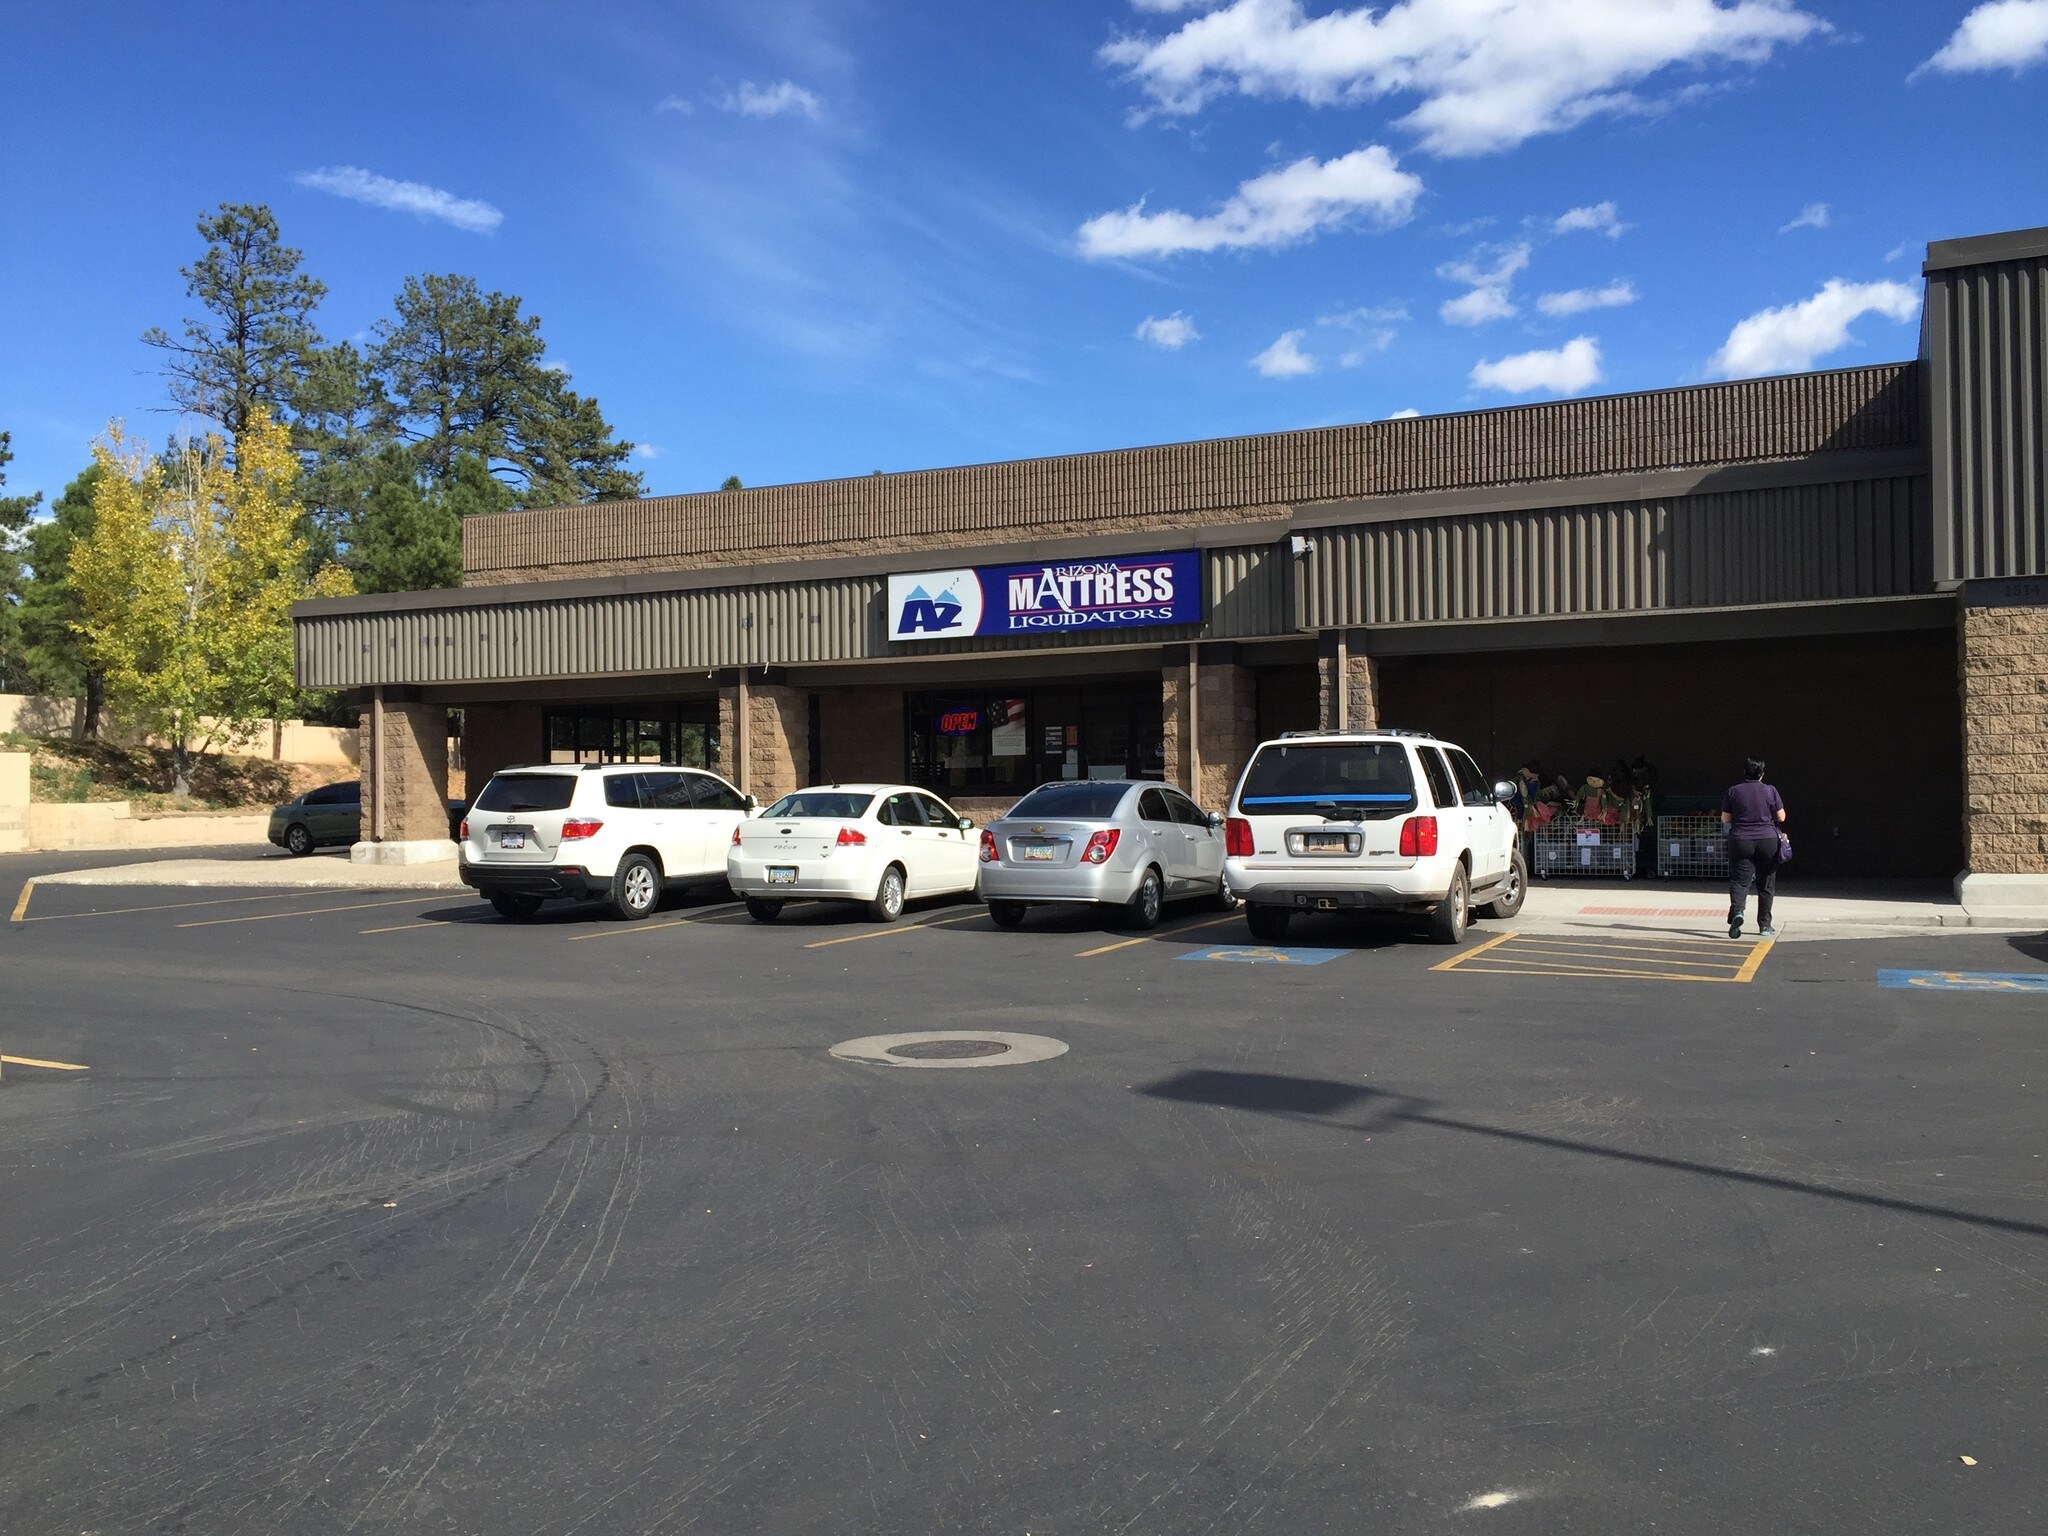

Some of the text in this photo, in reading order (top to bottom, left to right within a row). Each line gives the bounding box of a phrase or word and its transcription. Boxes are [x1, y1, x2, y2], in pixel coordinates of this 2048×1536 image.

[1008, 567, 1174, 612] MATTRESS
[897, 599, 962, 634] AZ
[1009, 607, 1173, 629] LIQUIDATORS
[941, 712, 977, 731] OPEN
